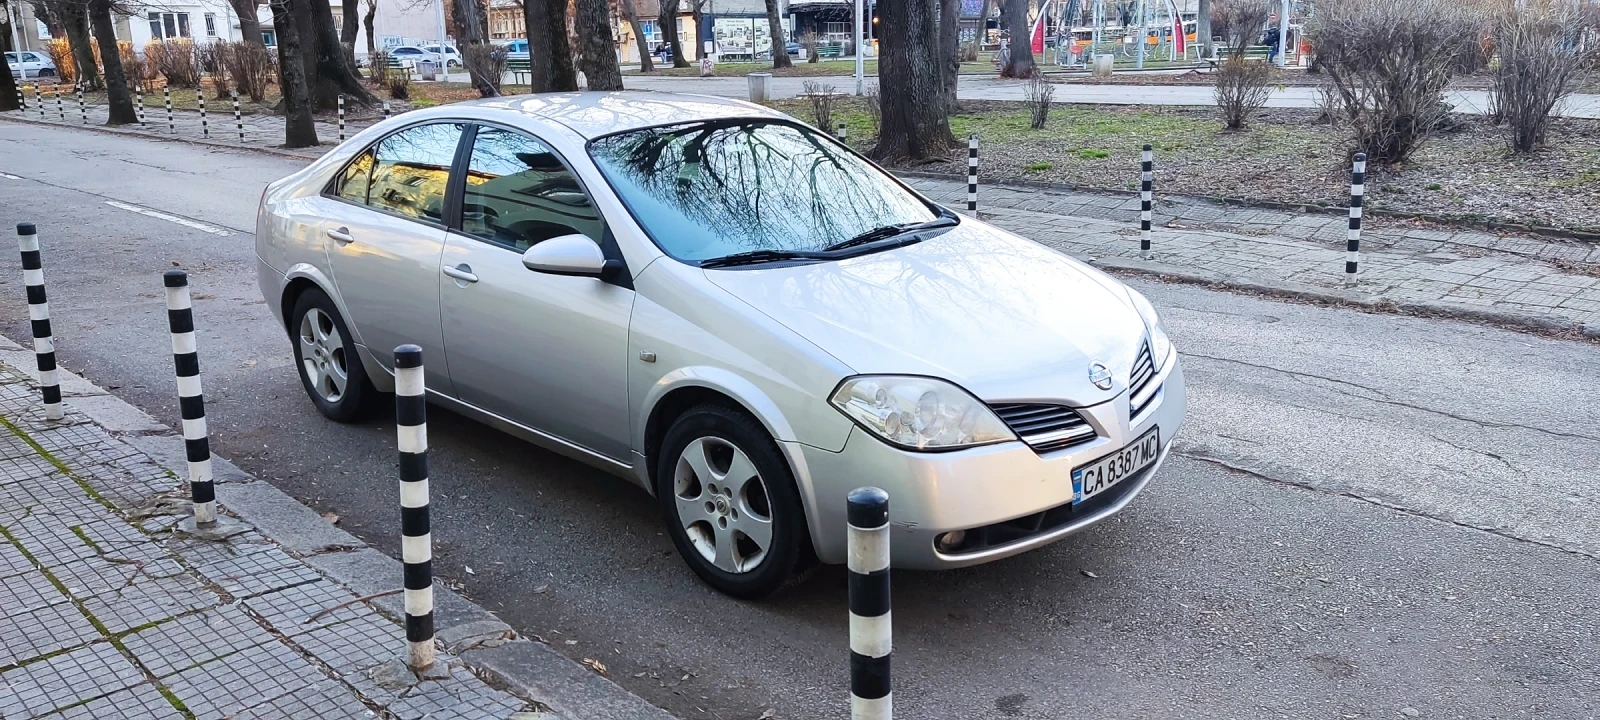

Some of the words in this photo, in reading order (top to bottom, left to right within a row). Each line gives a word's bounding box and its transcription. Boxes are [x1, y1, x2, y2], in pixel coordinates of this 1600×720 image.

[1084, 466, 1104, 495] CA
[1107, 445, 1139, 483] 8387
[1141, 435, 1156, 464] MC
